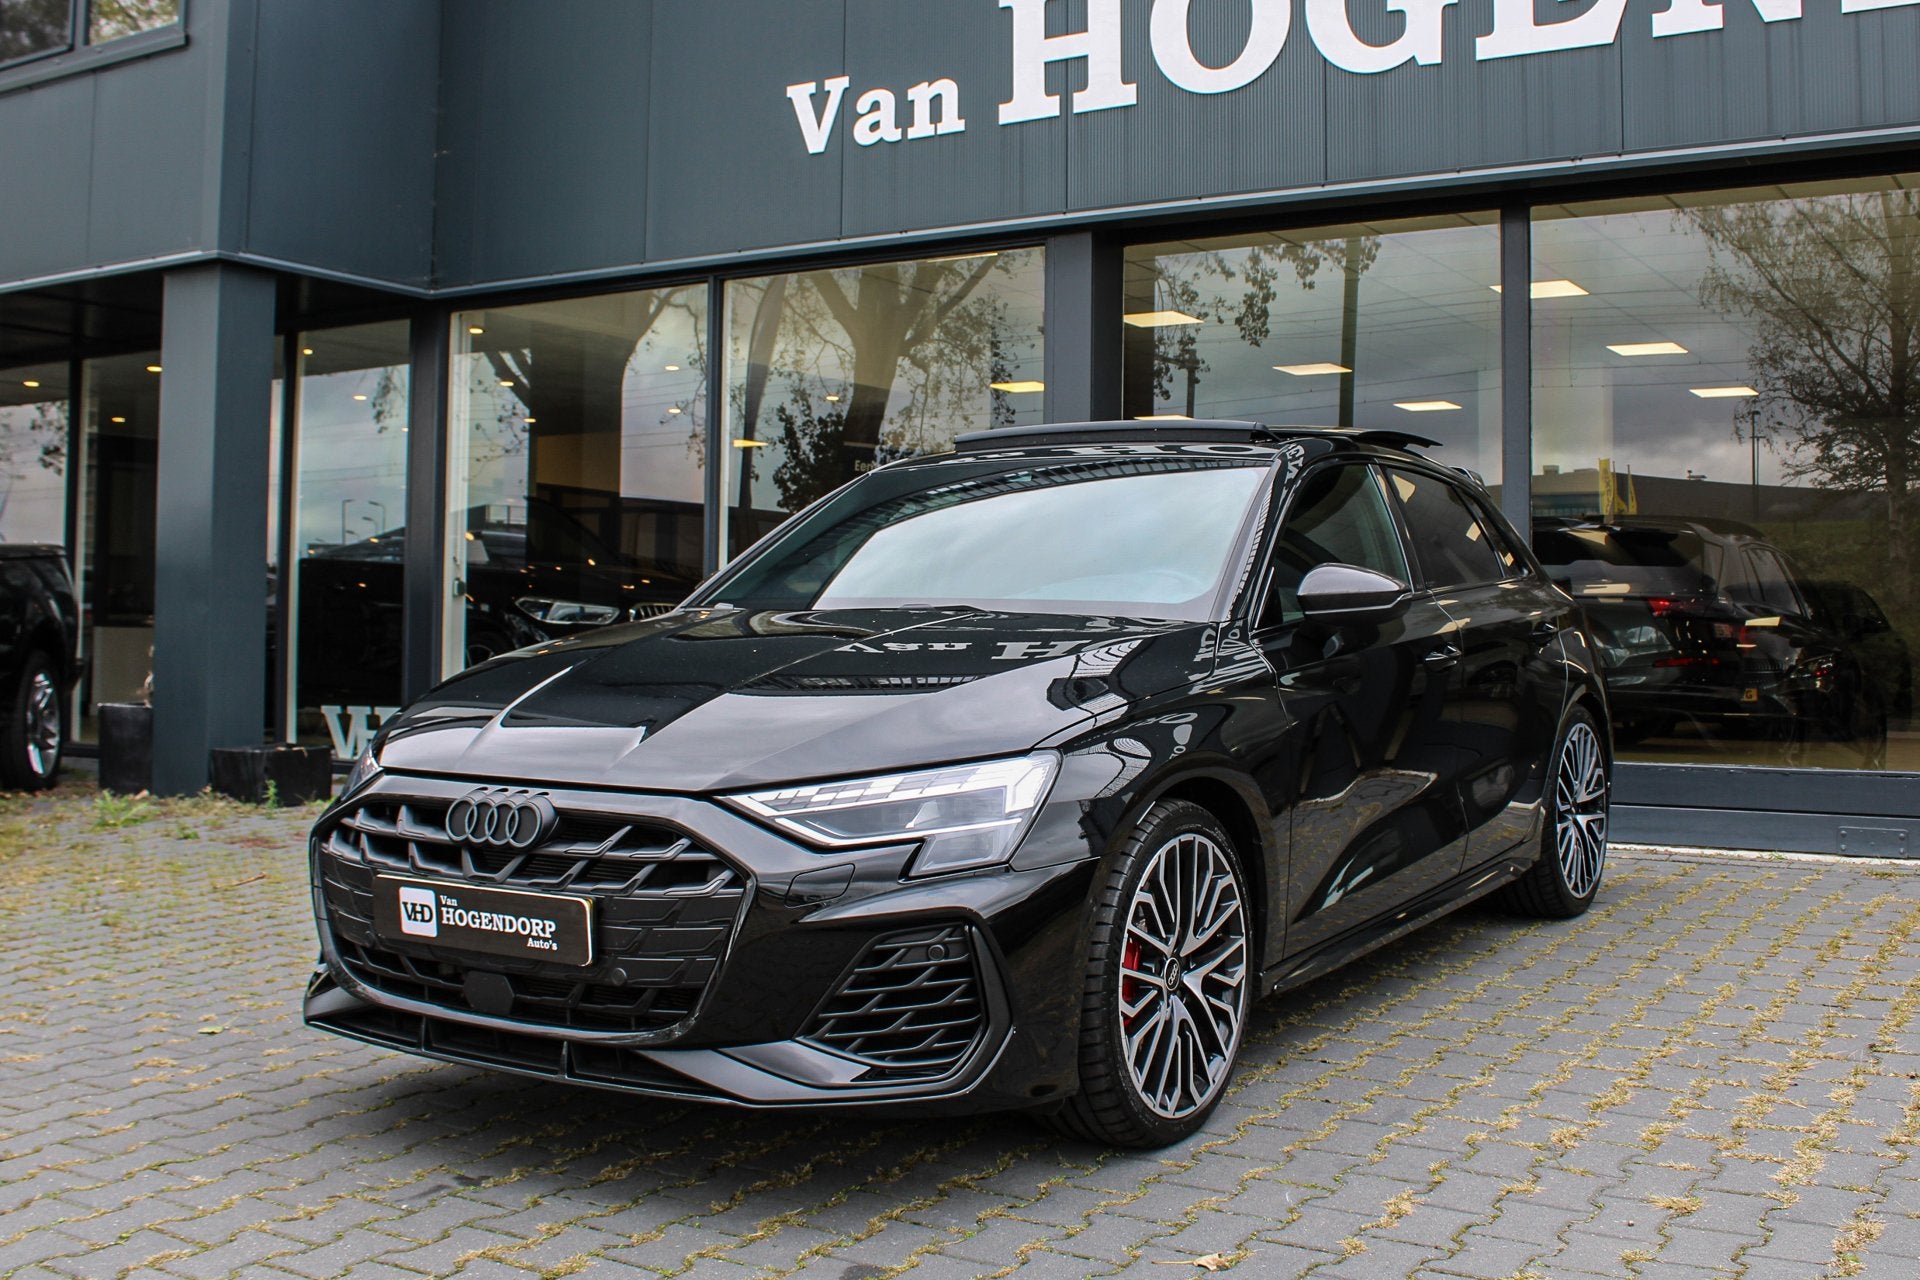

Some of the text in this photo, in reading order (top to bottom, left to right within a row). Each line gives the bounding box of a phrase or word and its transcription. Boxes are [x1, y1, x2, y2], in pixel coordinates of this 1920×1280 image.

[786, 76, 966, 155] Van
[440, 895, 458, 907] Van
[441, 907, 556, 938] HOGENDORP
[527, 937, 558, 950] Auto's
